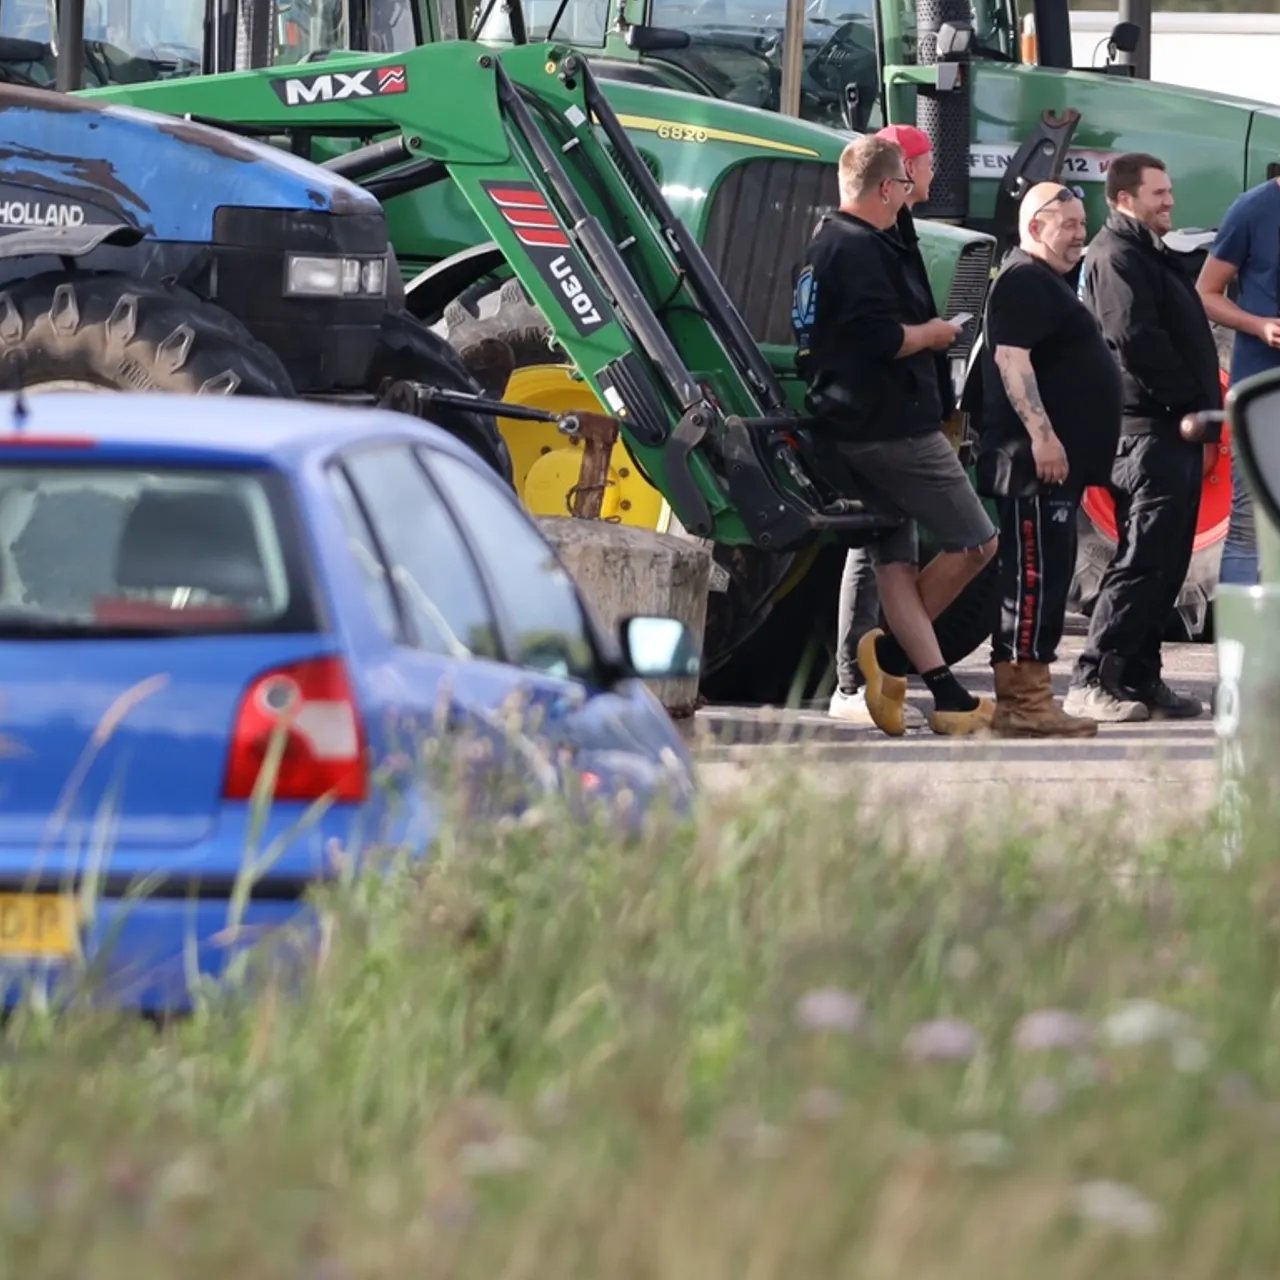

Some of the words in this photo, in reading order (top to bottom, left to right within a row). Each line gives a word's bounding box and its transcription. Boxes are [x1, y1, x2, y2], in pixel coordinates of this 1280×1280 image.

[284, 69, 374, 106] MX
[657, 124, 709, 144] 6820
[548, 254, 603, 326] U307
